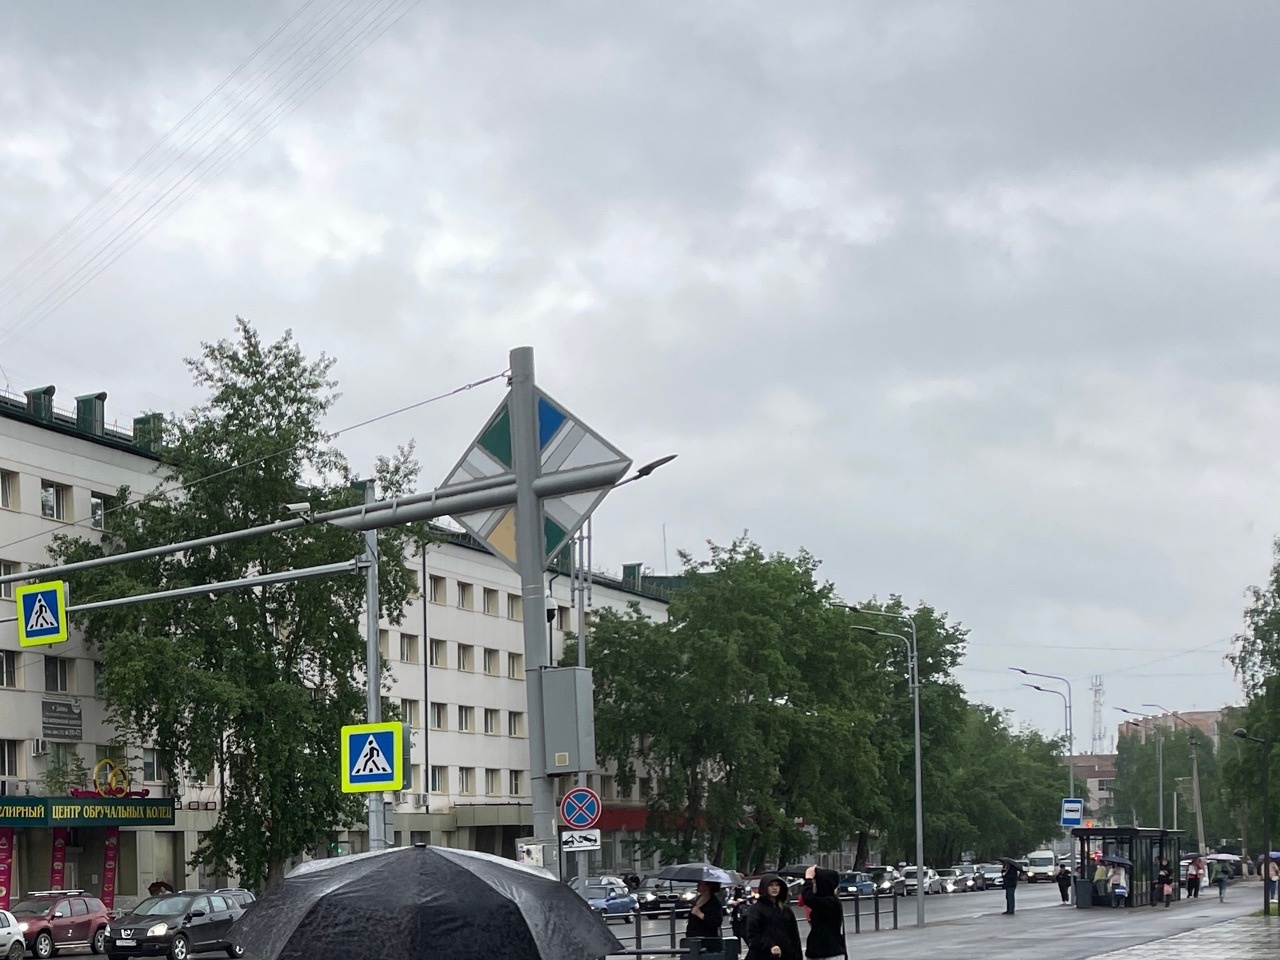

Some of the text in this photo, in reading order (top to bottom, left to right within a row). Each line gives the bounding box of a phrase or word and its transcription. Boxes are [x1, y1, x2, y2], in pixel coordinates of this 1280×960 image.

[52, 805, 81, 820] ЦЕНТР
[83, 805, 144, 819] ОБРУЧАЛЬНЫХ
[146, 806, 172, 819] КОЛЕЦ
